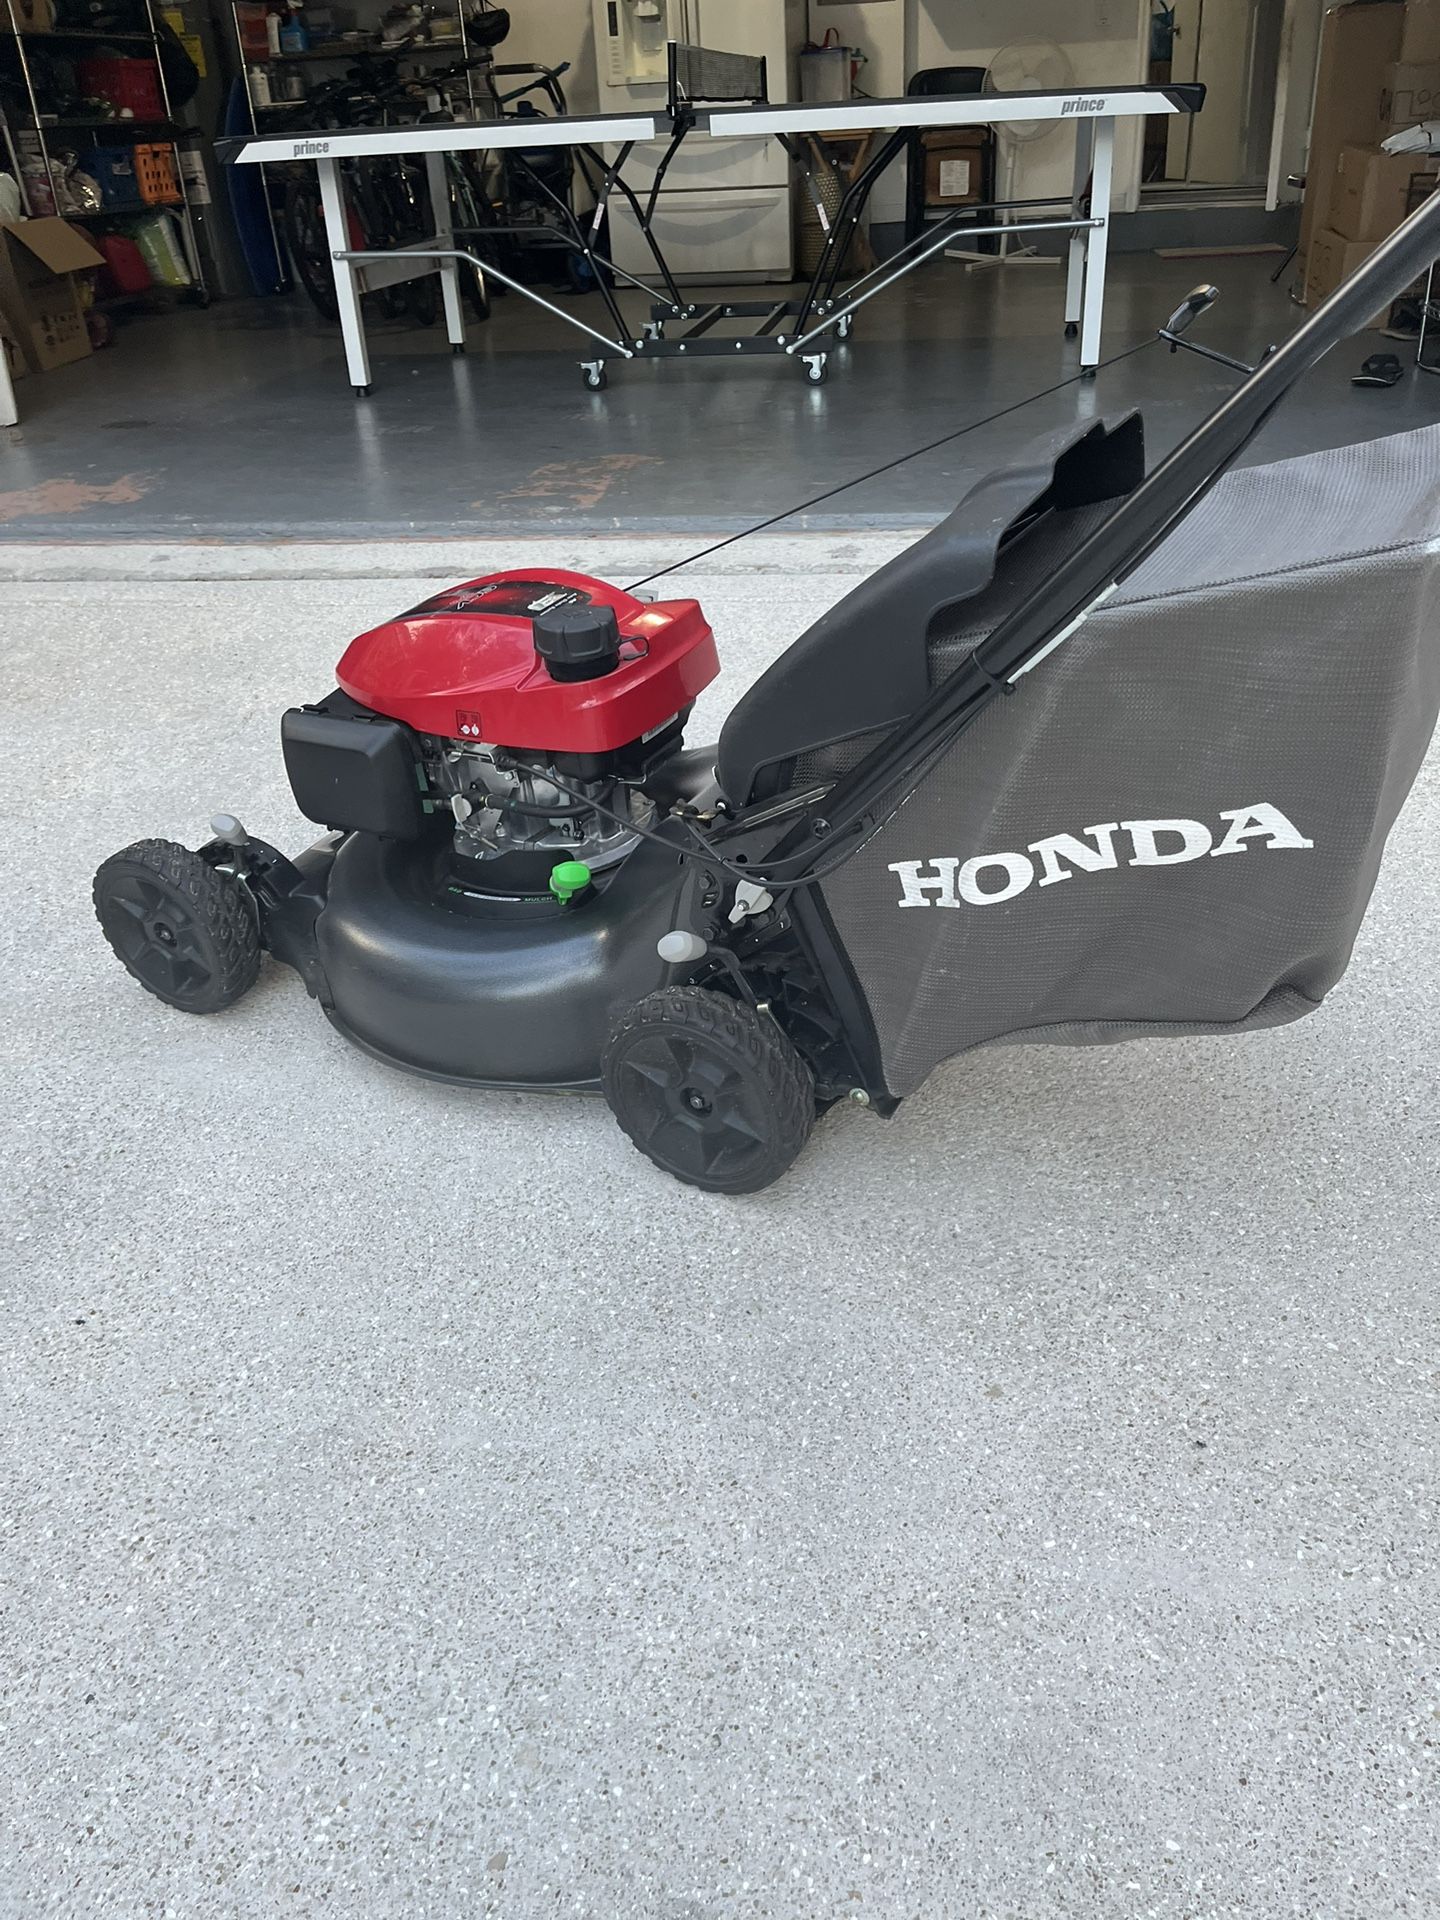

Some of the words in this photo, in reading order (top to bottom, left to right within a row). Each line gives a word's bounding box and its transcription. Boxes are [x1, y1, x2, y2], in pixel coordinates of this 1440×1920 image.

[1061, 97, 1105, 115] prince
[293, 140, 329, 157] prince
[888, 802, 1314, 909] HONDA
